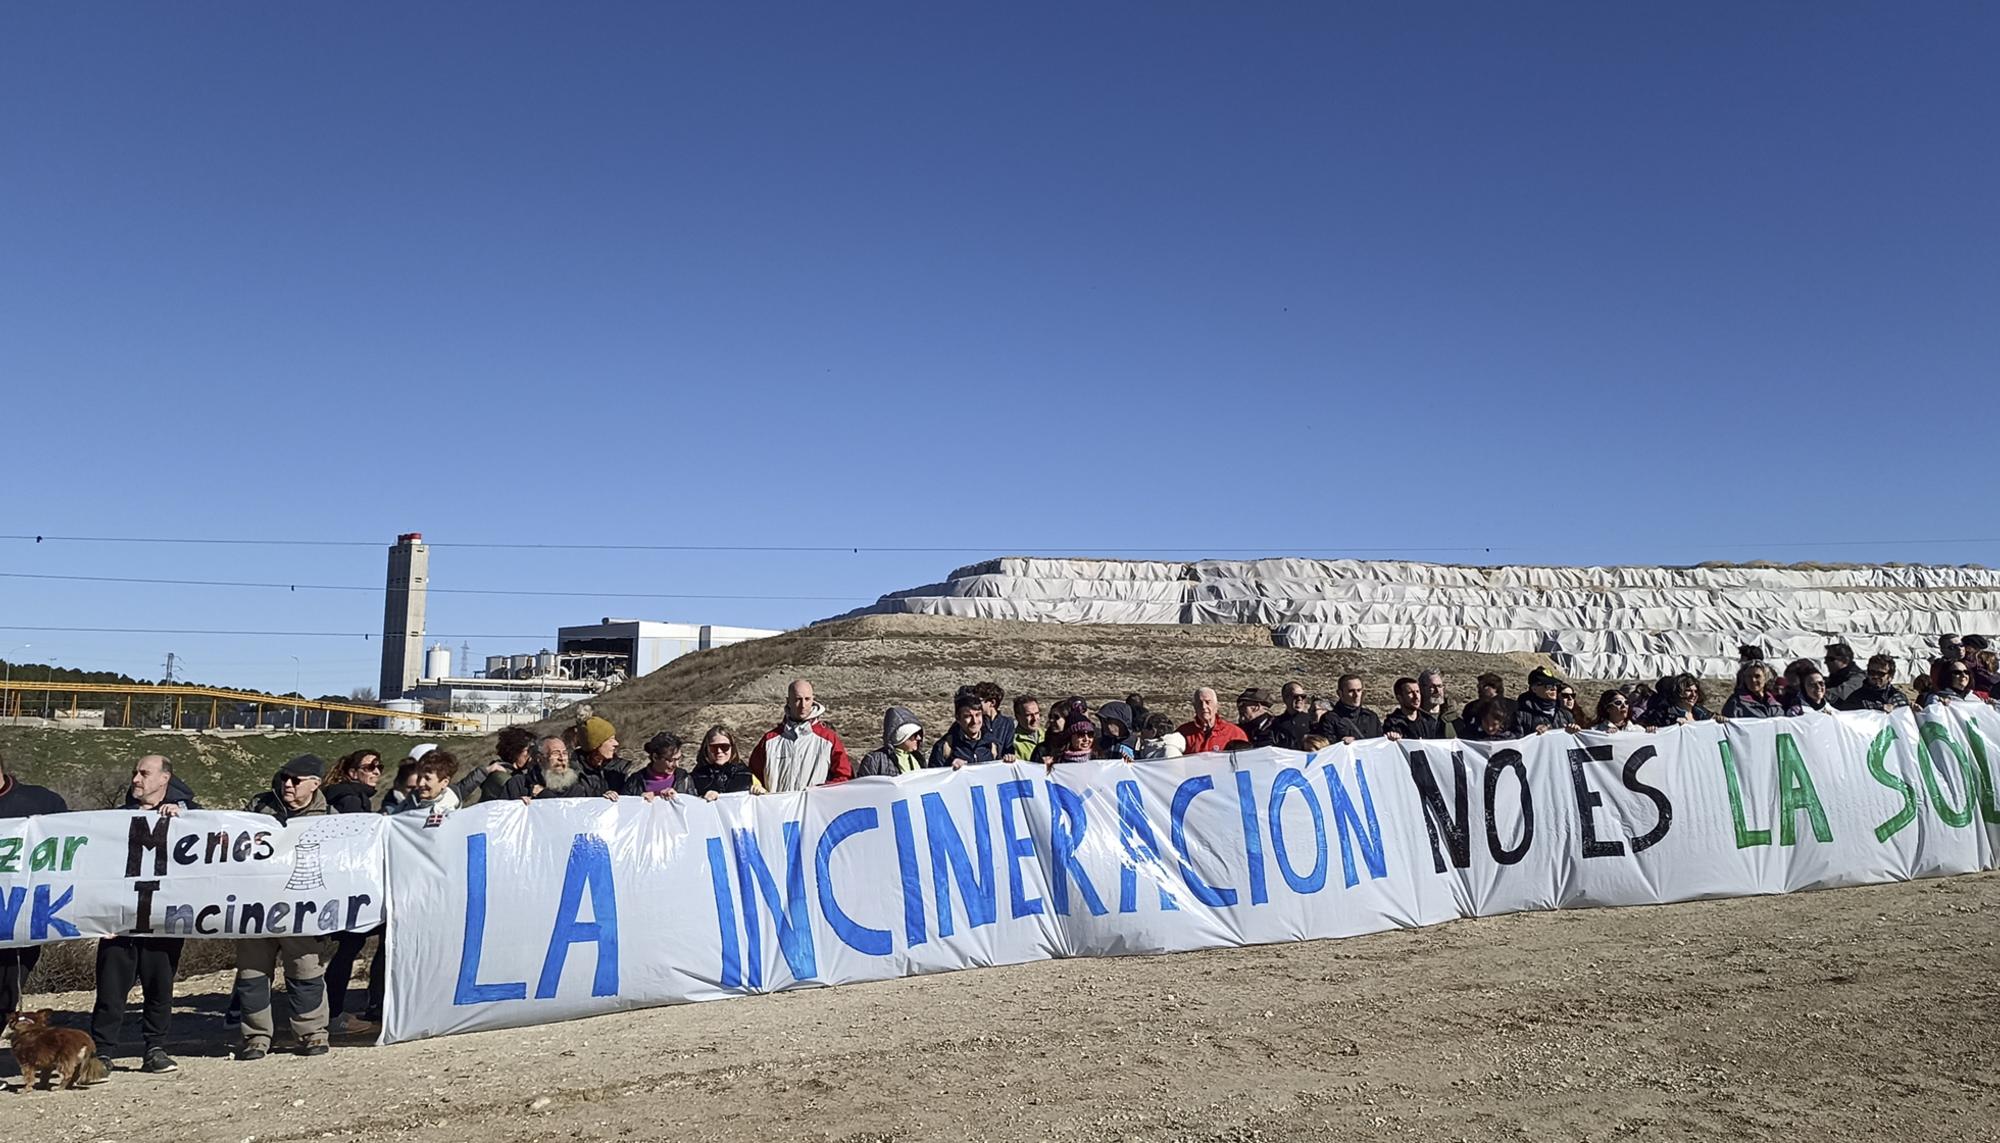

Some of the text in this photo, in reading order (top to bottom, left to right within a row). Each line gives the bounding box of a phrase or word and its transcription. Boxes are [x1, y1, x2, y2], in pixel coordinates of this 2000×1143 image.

[128, 880, 373, 935] Incinerar
[453, 832, 619, 1006] LA
[706, 752, 1387, 989] INCINERACIÓN
[1410, 747, 1535, 874] NO
[1566, 744, 1673, 859] ES
[1717, 732, 1834, 850] LA
